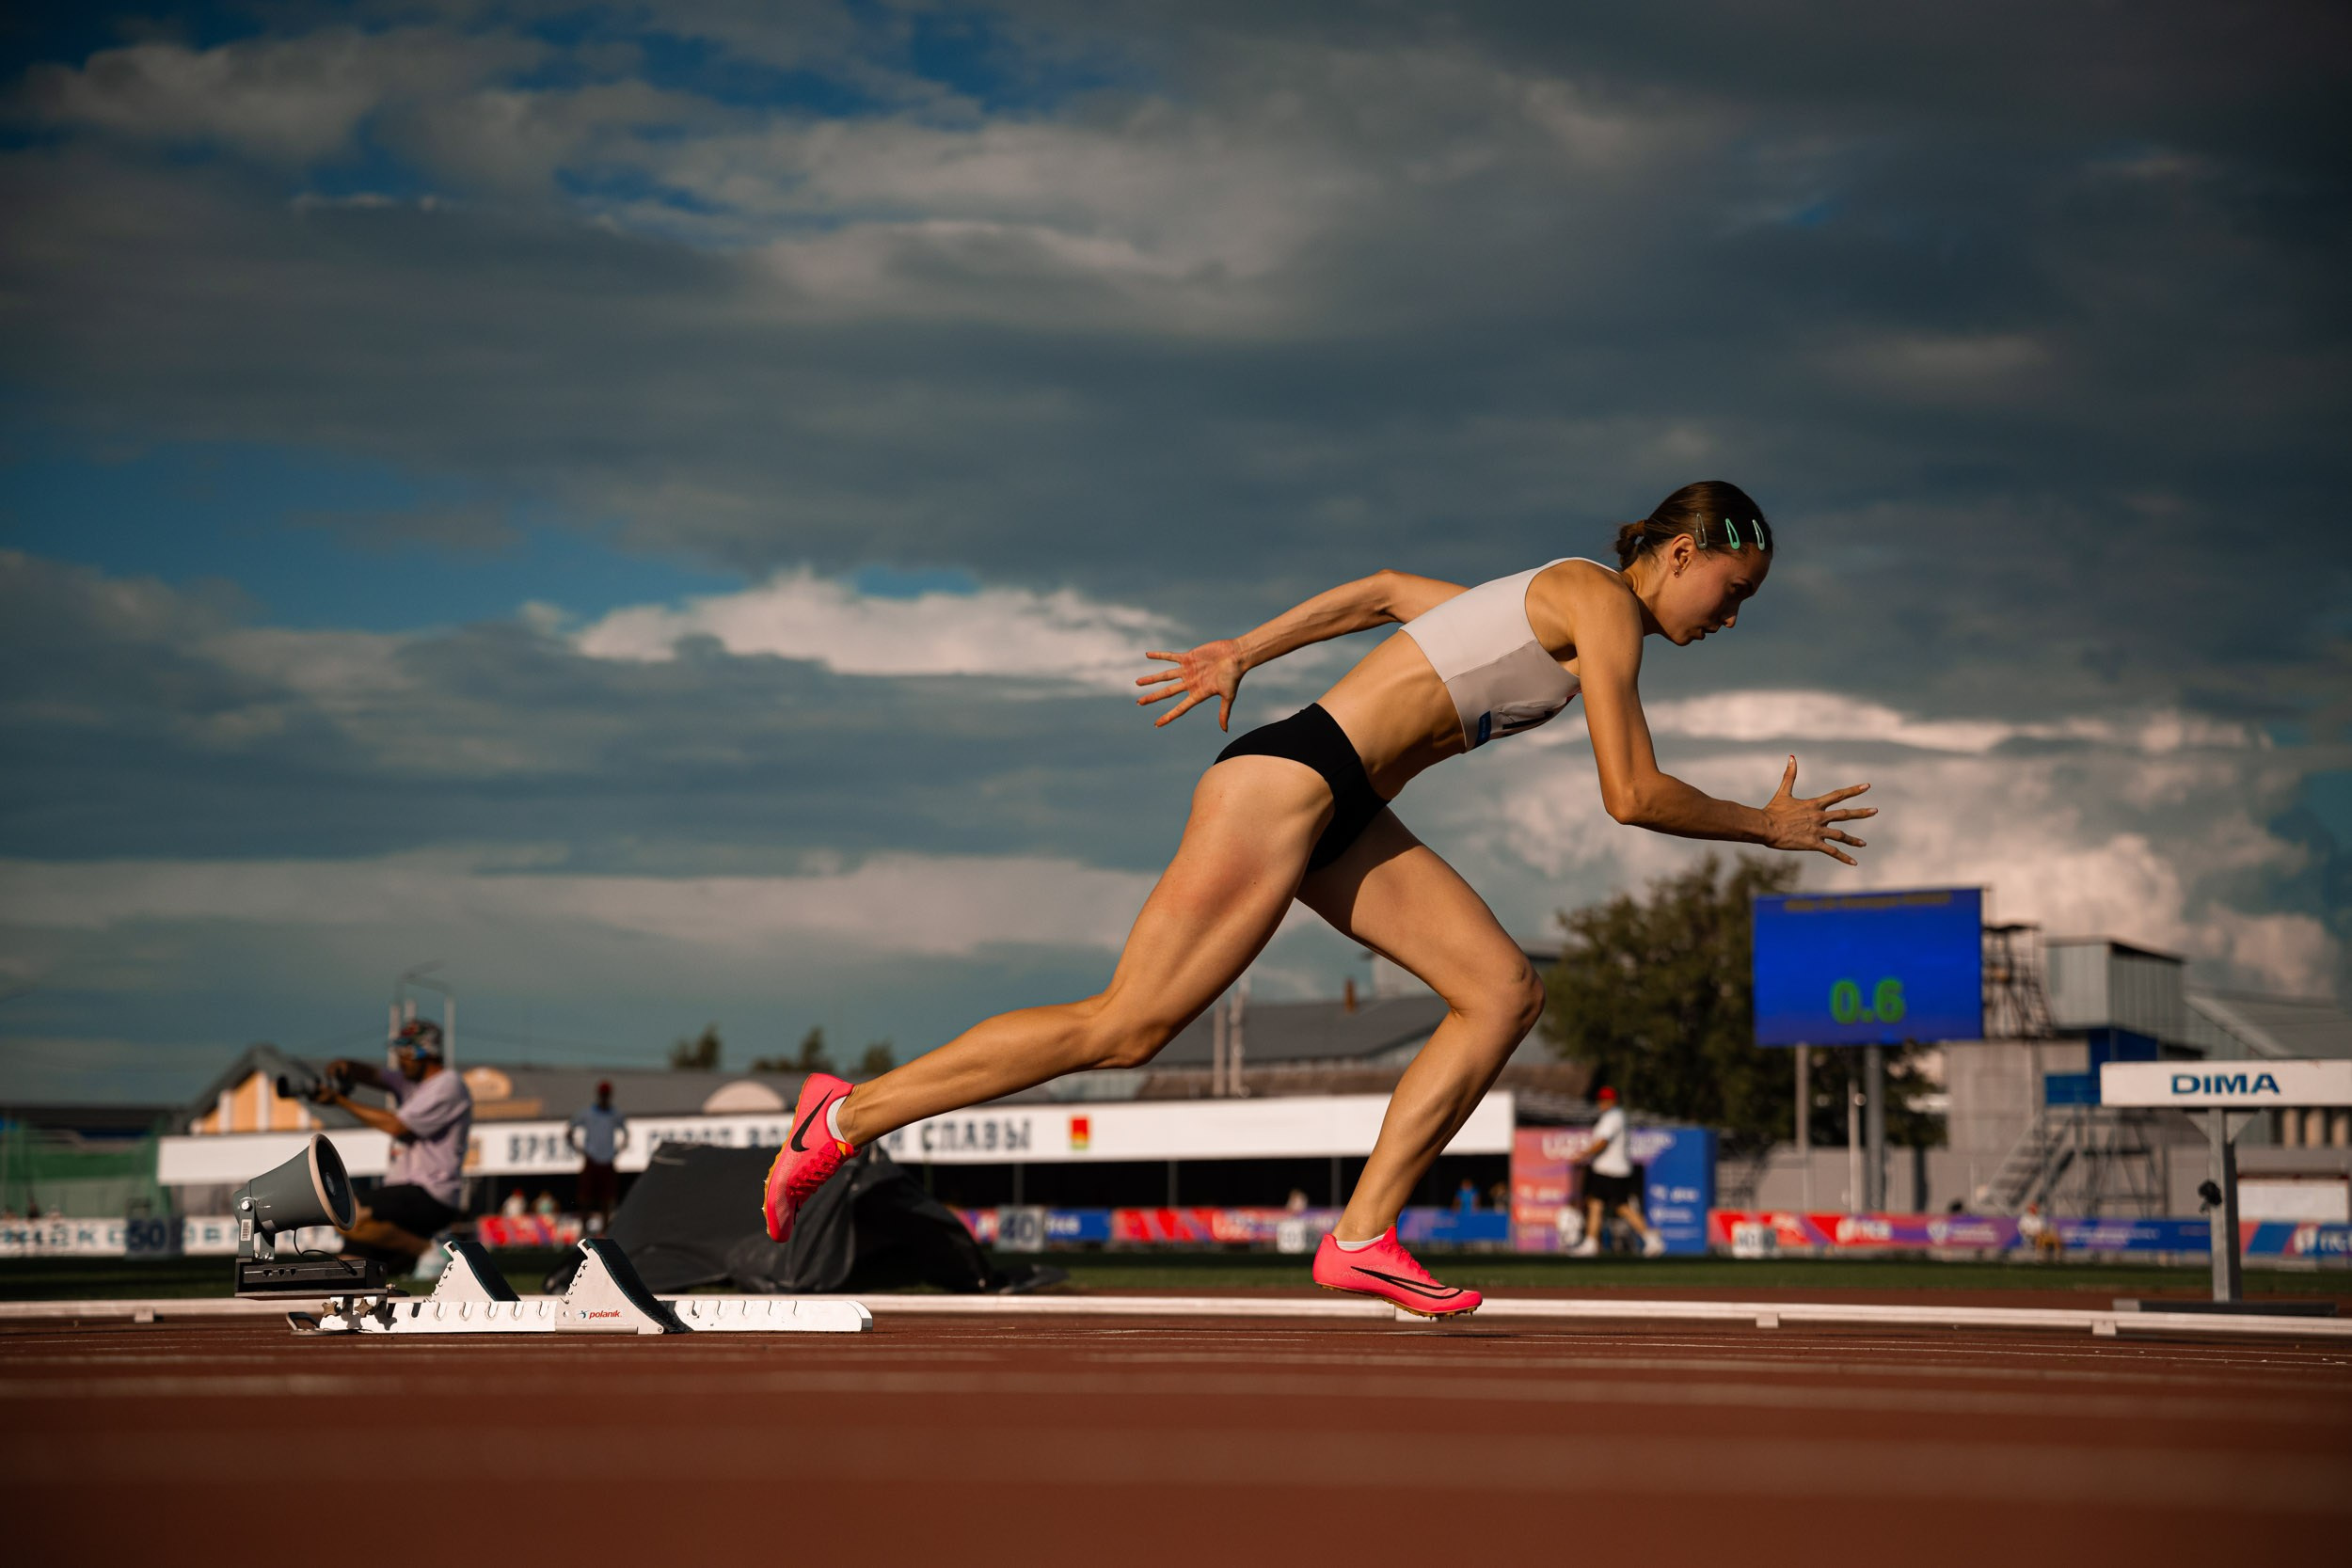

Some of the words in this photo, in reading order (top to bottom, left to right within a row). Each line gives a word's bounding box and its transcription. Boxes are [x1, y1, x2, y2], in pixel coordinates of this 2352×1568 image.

[1829, 977, 1906, 1024] 0.6
[2171, 1072, 2280, 1094] DIMA
[126, 1219, 167, 1251] 50
[999, 1214, 1037, 1243] 40
[589, 1310, 621, 1320] polanik
